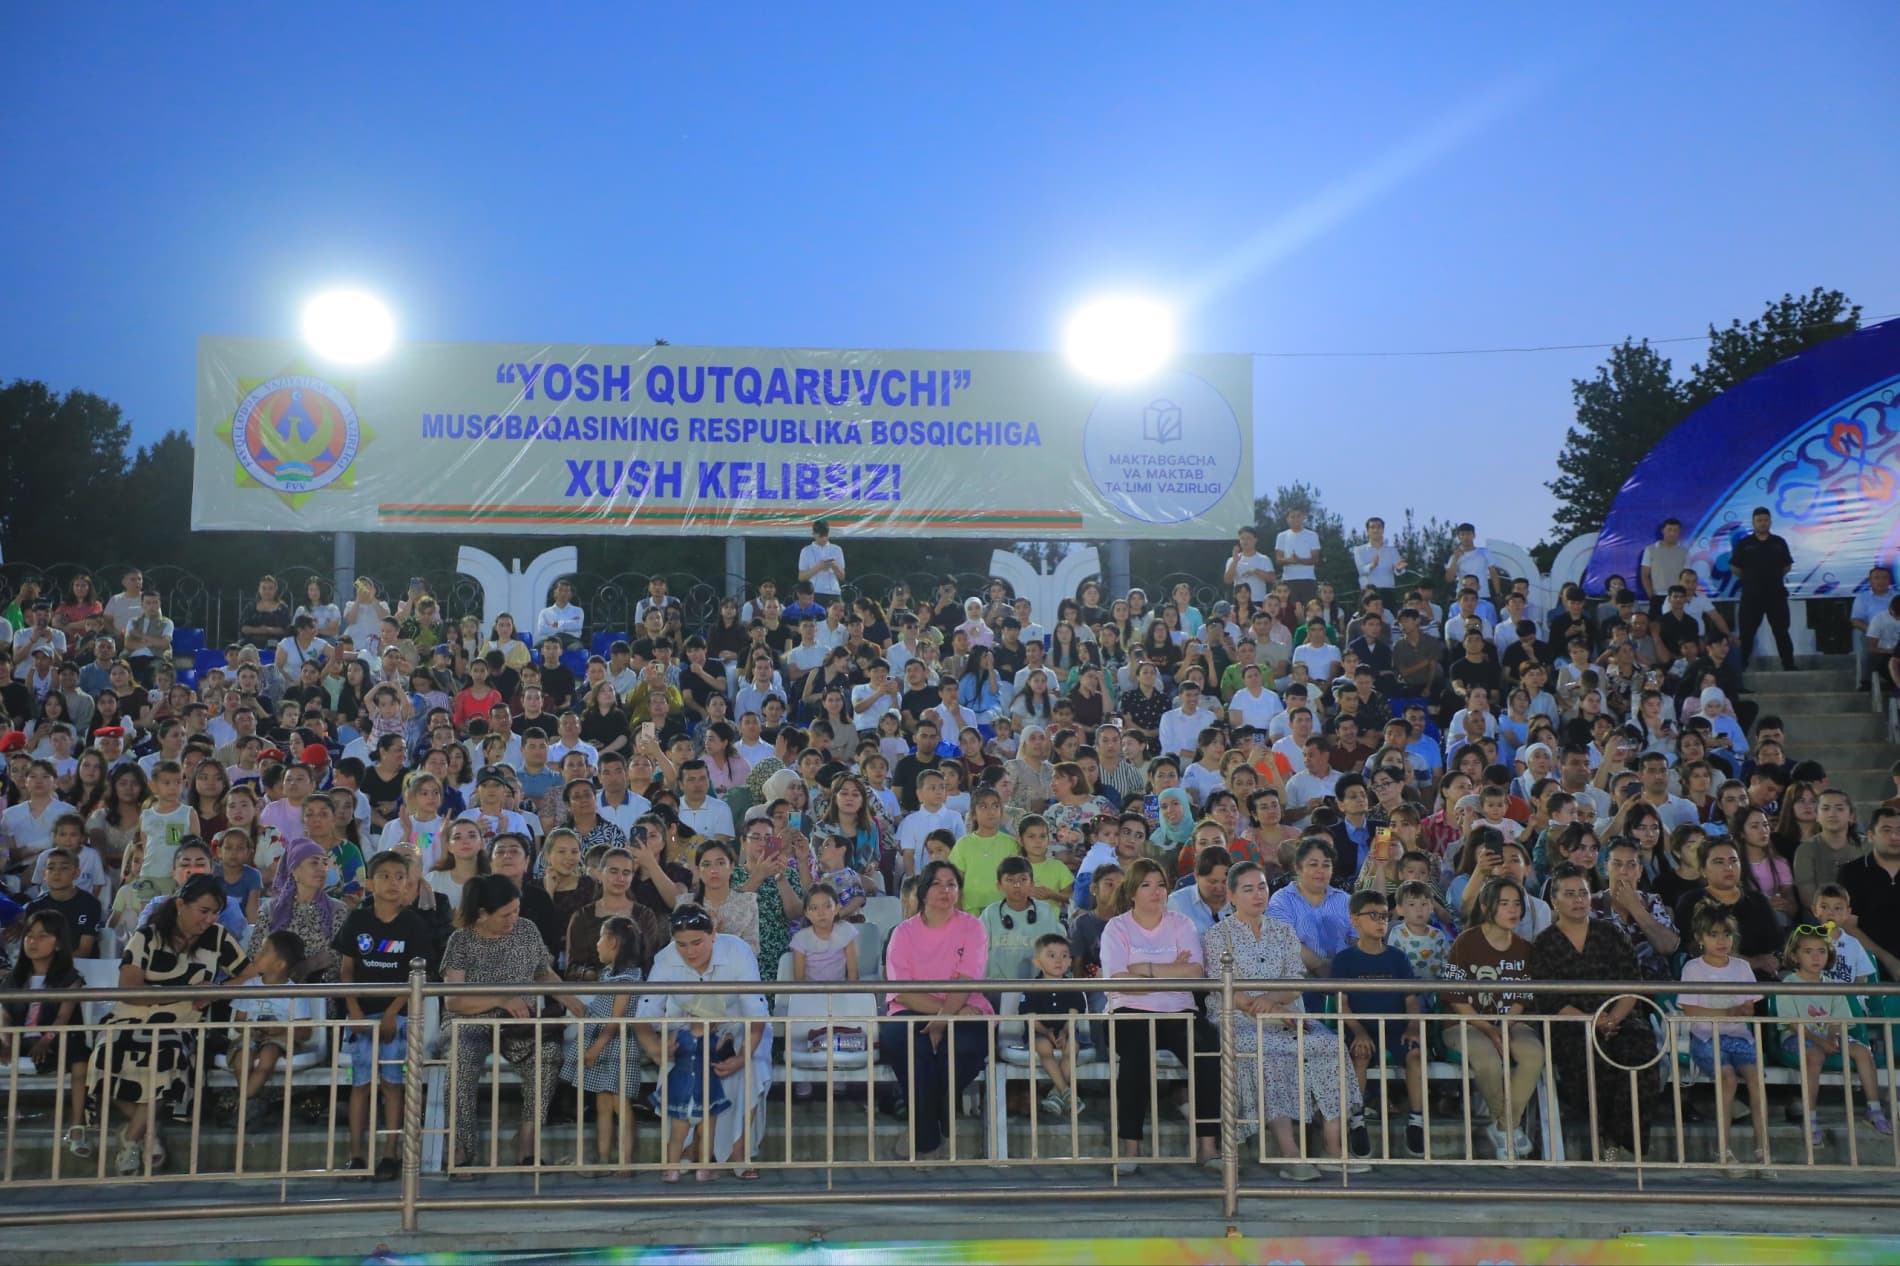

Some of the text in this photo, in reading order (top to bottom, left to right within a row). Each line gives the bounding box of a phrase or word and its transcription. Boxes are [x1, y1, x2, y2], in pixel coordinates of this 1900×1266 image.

[421, 413, 1042, 447] MUSOBAQASINING RESPUBLIKA BOSQICHIGA
[1109, 455, 1217, 467] MAKTABGACHA
[564, 460, 901, 501] XUSH KELIBSIZ!
[1122, 468, 1204, 480] VA MAKTAB
[1158, 482, 1222, 495] VAZIRLIGI
